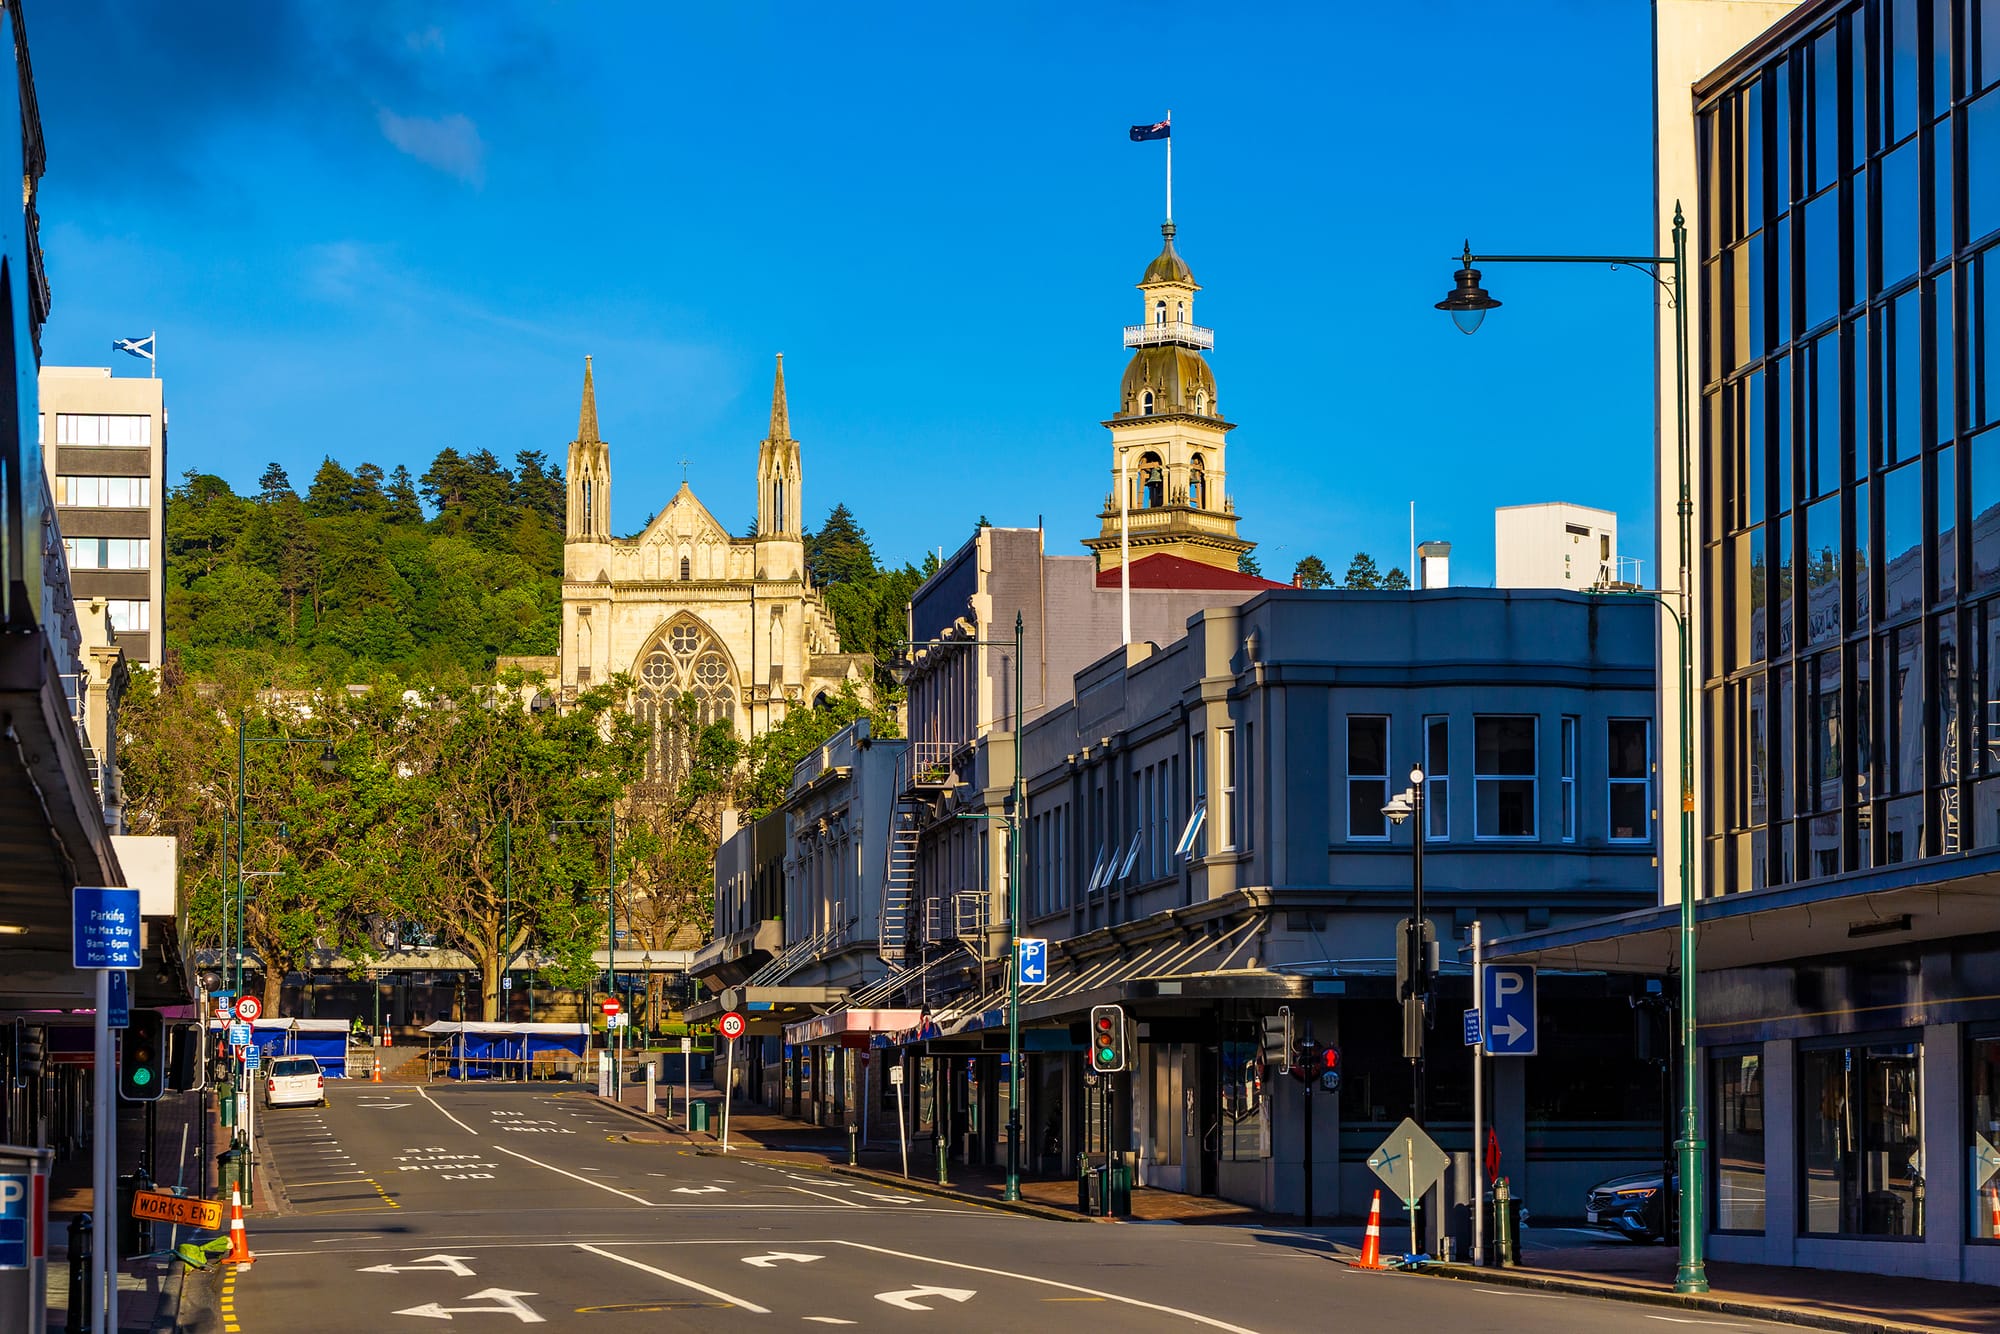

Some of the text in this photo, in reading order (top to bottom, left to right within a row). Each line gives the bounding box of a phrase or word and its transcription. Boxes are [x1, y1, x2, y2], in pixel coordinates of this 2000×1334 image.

[91, 910, 125, 923] Parking
[99, 926, 114, 935] Max
[115, 926, 133, 937] Stay
[1027, 945, 1039, 961] P
[114, 973, 120, 990] P
[1496, 972, 1524, 1008] P
[241, 1004, 256, 1014] 30
[726, 1020, 739, 1031] 30
[392, 1154, 482, 1162] TURN
[398, 1163, 500, 1171] RIGHT
[440, 1173, 496, 1181] NO
[0, 1180, 24, 1214] P
[140, 1198, 216, 1222] WORKS END
